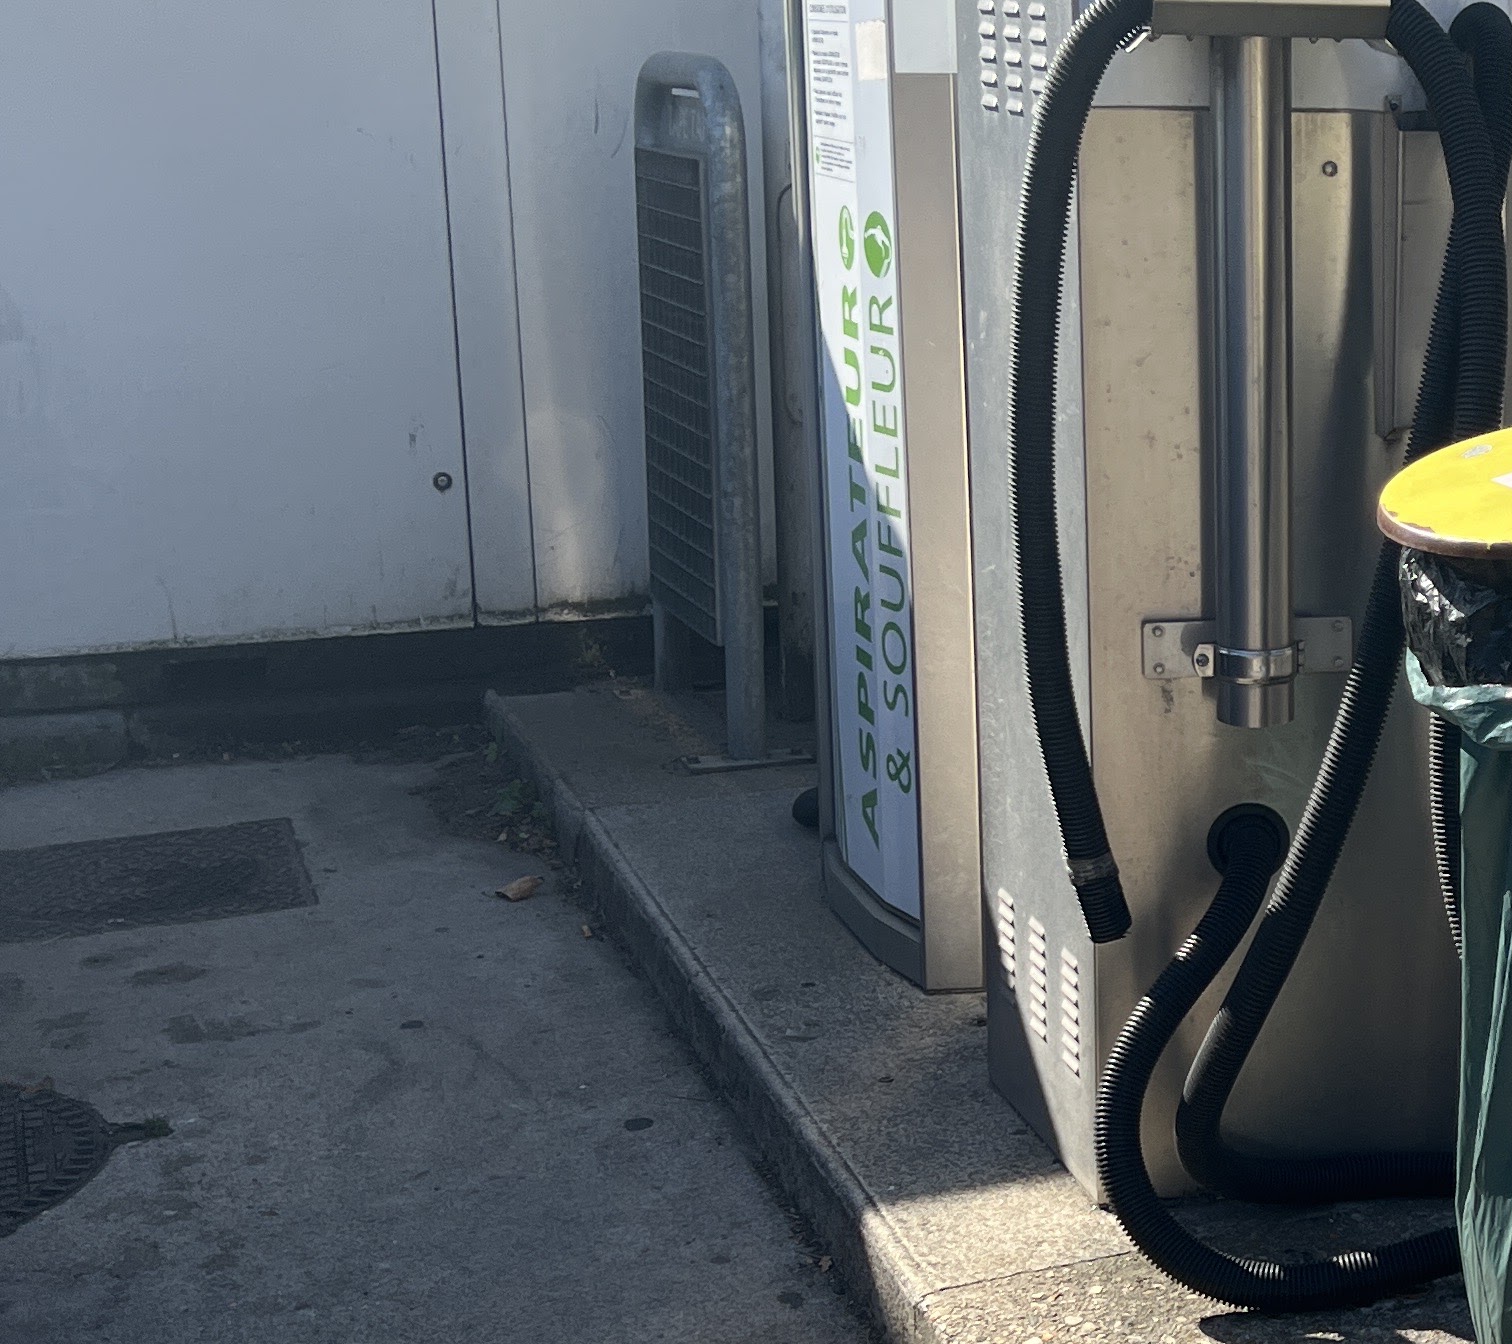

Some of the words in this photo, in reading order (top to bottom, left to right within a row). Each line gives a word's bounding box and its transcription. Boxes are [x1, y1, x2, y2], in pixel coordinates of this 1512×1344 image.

[841, 285, 880, 849] ASPIRATEUR
[867, 294, 911, 716] SOUFFLEUR
[884, 748, 913, 795] &
